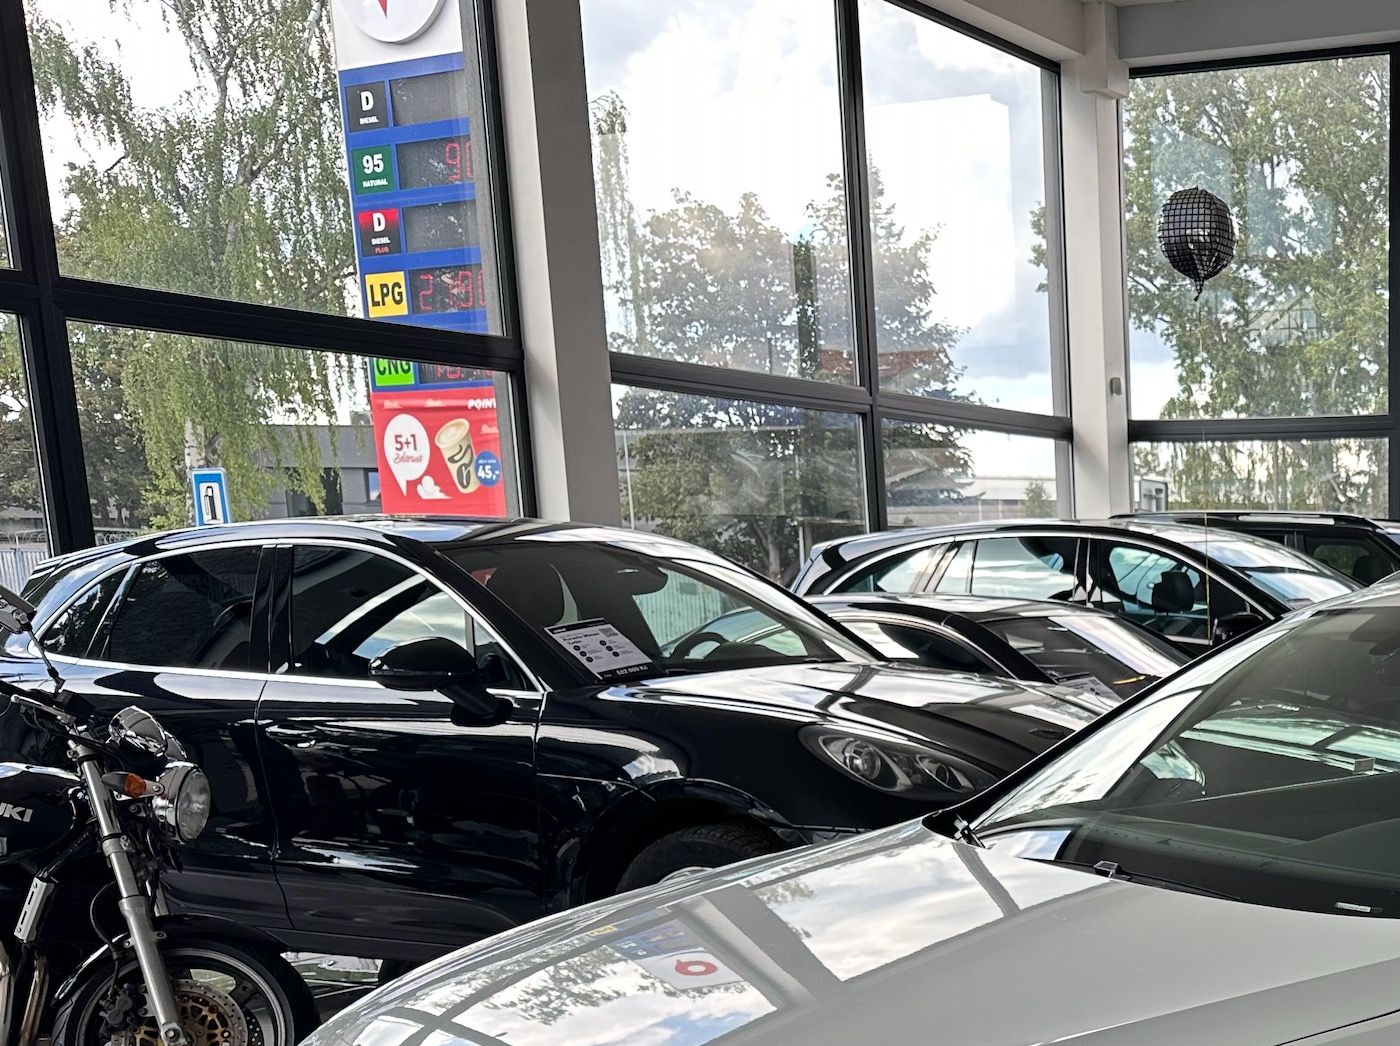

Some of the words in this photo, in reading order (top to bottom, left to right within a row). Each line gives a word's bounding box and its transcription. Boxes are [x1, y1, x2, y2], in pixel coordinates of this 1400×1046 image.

[360, 91, 374, 111] D
[359, 116, 379, 125] DIESEL
[362, 153, 384, 174] 95
[362, 178, 388, 188] NATURAL
[372, 212, 386, 232] D
[371, 236, 391, 245] DIESEL
[369, 281, 404, 308] LPG
[375, 358, 411, 376] CNG
[394, 433, 418, 452] 5+1
